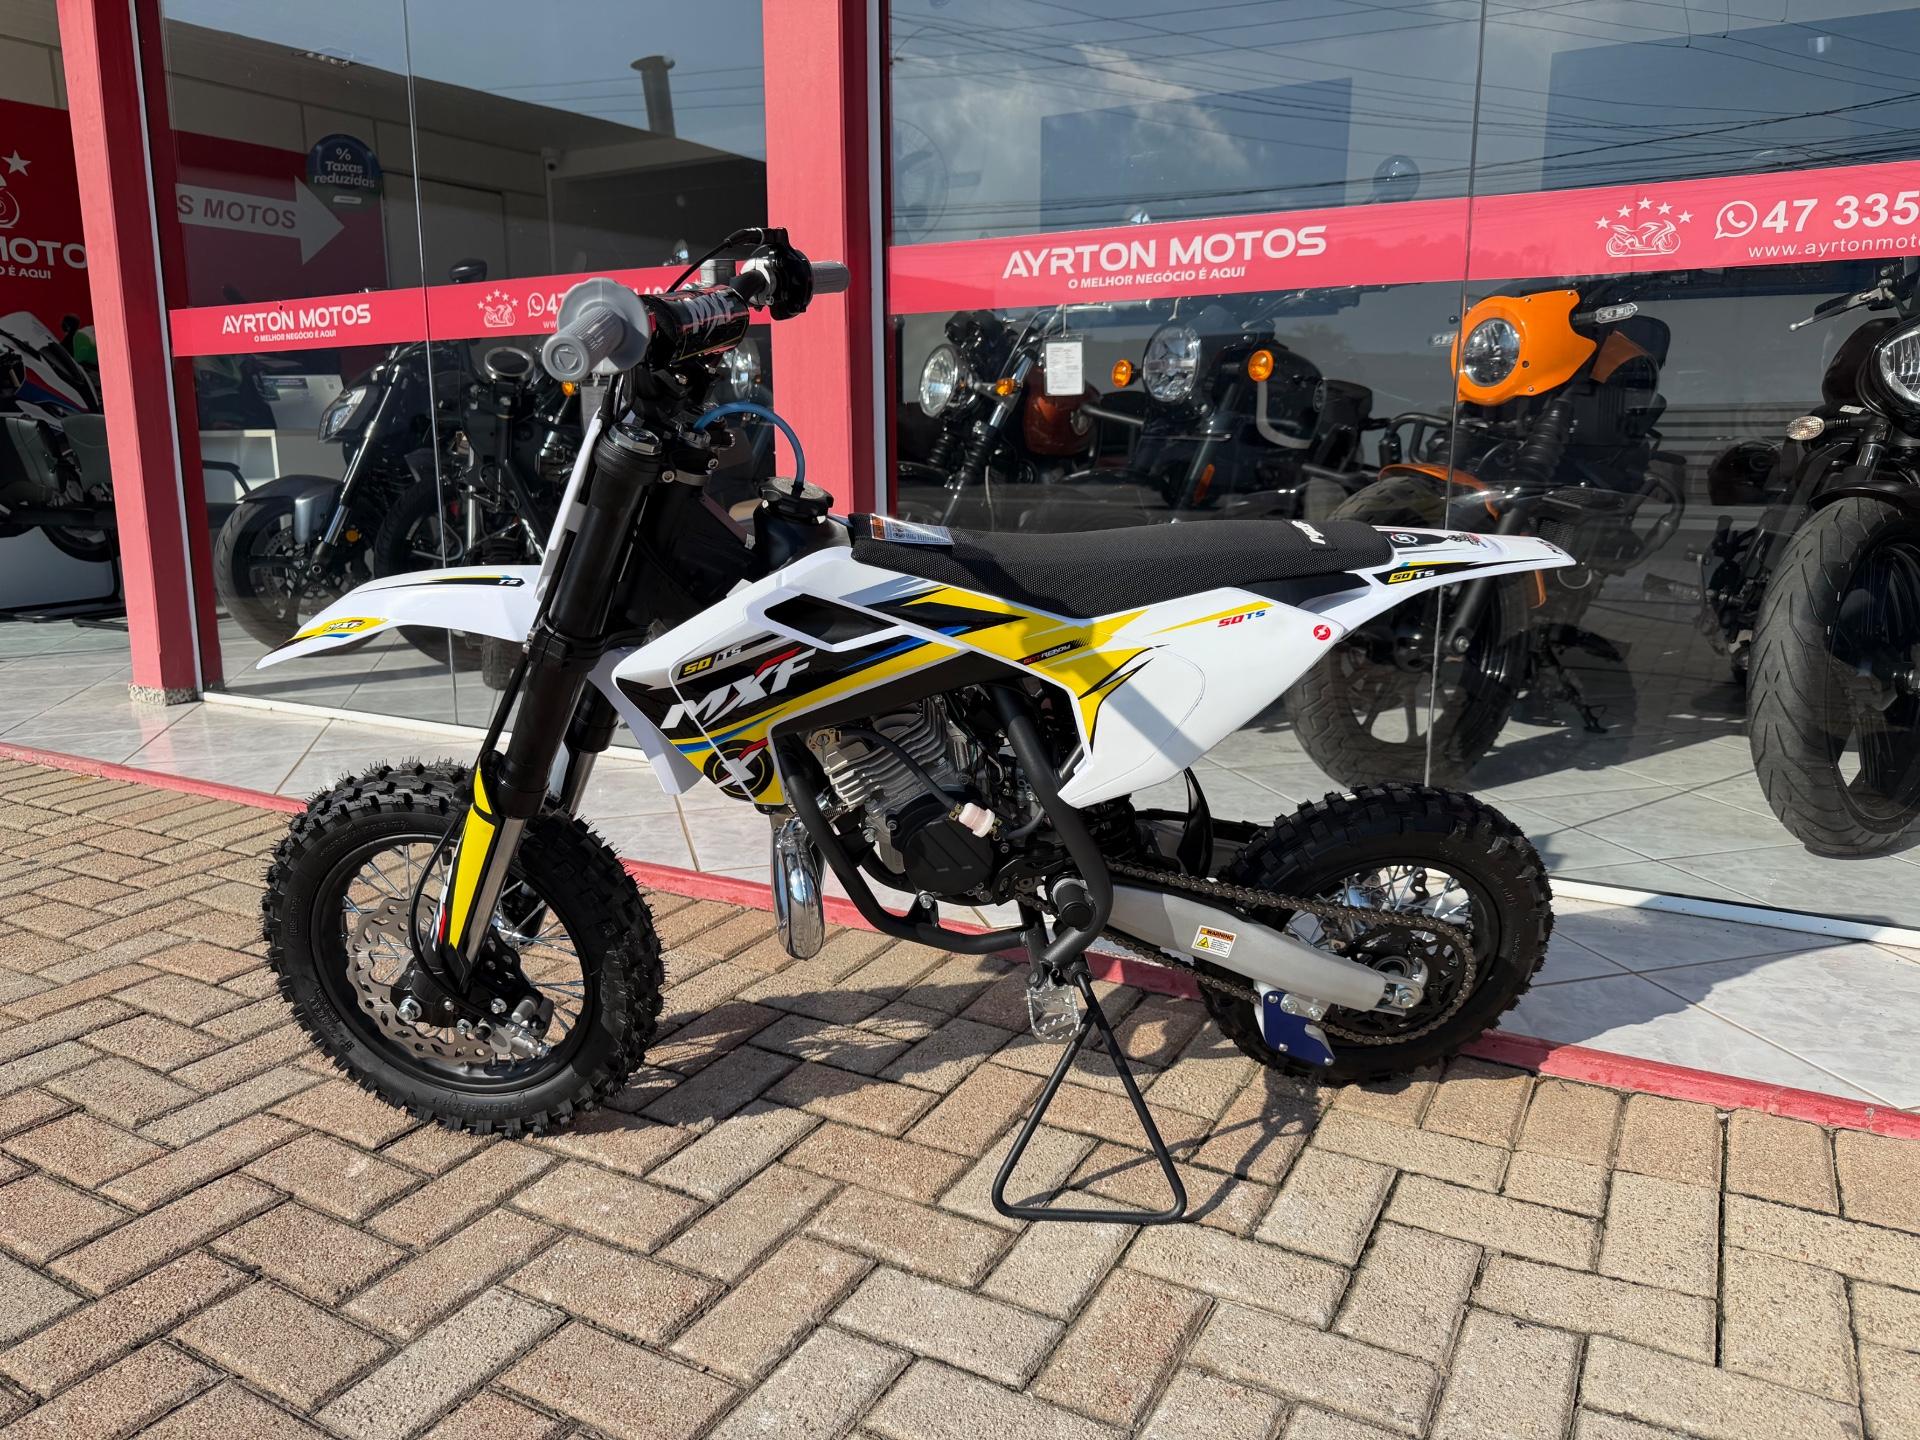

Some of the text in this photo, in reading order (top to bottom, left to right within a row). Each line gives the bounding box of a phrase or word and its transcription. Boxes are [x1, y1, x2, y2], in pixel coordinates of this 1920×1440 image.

[325, 161, 363, 174] Taxas
[314, 173, 375, 188] reduzidas
[203, 198, 296, 230] MOTOS
[1762, 198, 1819, 234] 47
[1002, 225, 1327, 279] AYRTON MOTOS
[1748, 233, 1920, 258] www.ayrtonmot
[8, 265, 16, 276] É
[19, 268, 51, 280] AQUI
[1068, 266, 1245, 289] O MELHOR NEGÓCIO É AQUI
[222, 303, 371, 335] AYRTON MOTOS
[254, 335, 259, 343] O
[260, 332, 285, 342] MELHOR
[286, 330, 314, 341] NEGÓCIO
[320, 329, 336, 338] AQUI
[683, 656, 712, 676] 50
[660, 646, 817, 729] MXF
